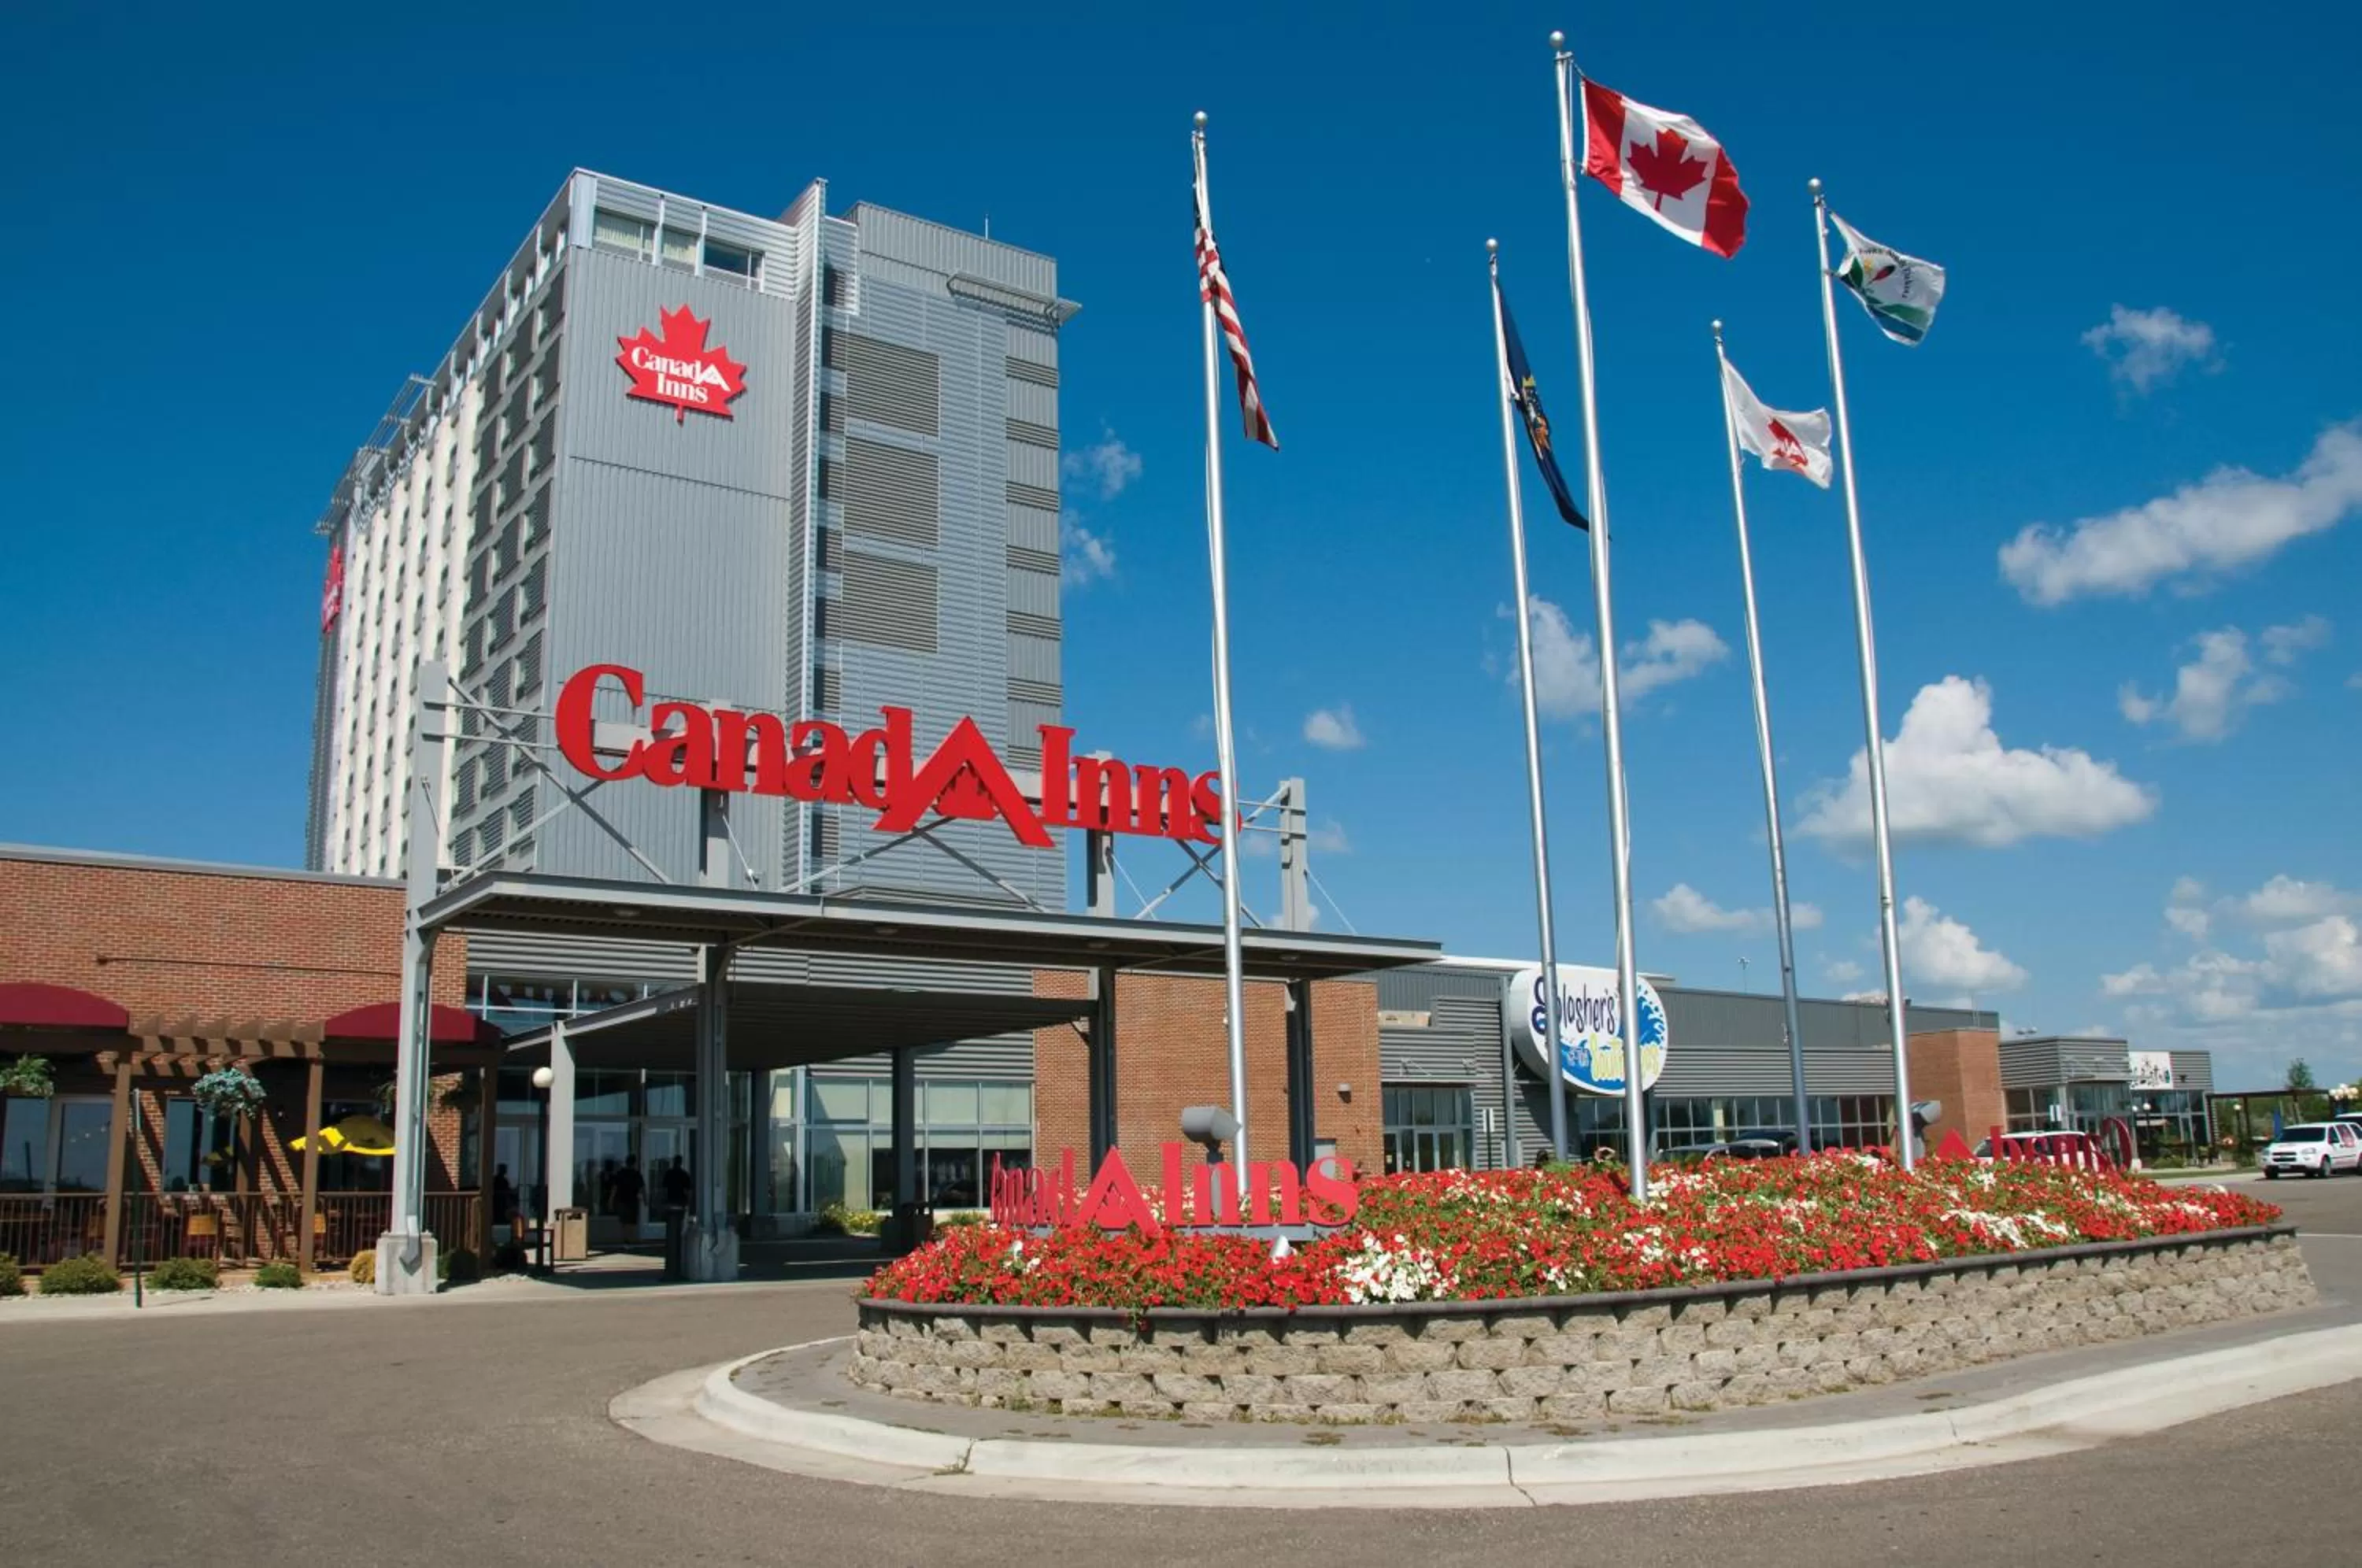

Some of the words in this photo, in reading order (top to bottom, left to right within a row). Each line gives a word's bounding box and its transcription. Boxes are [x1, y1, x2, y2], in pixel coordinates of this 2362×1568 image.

[656, 373, 708, 404] Inns
[1035, 723, 1243, 846] Inns
[1531, 975, 1615, 1035] Slasher's
[1159, 1142, 1359, 1226] Inns
